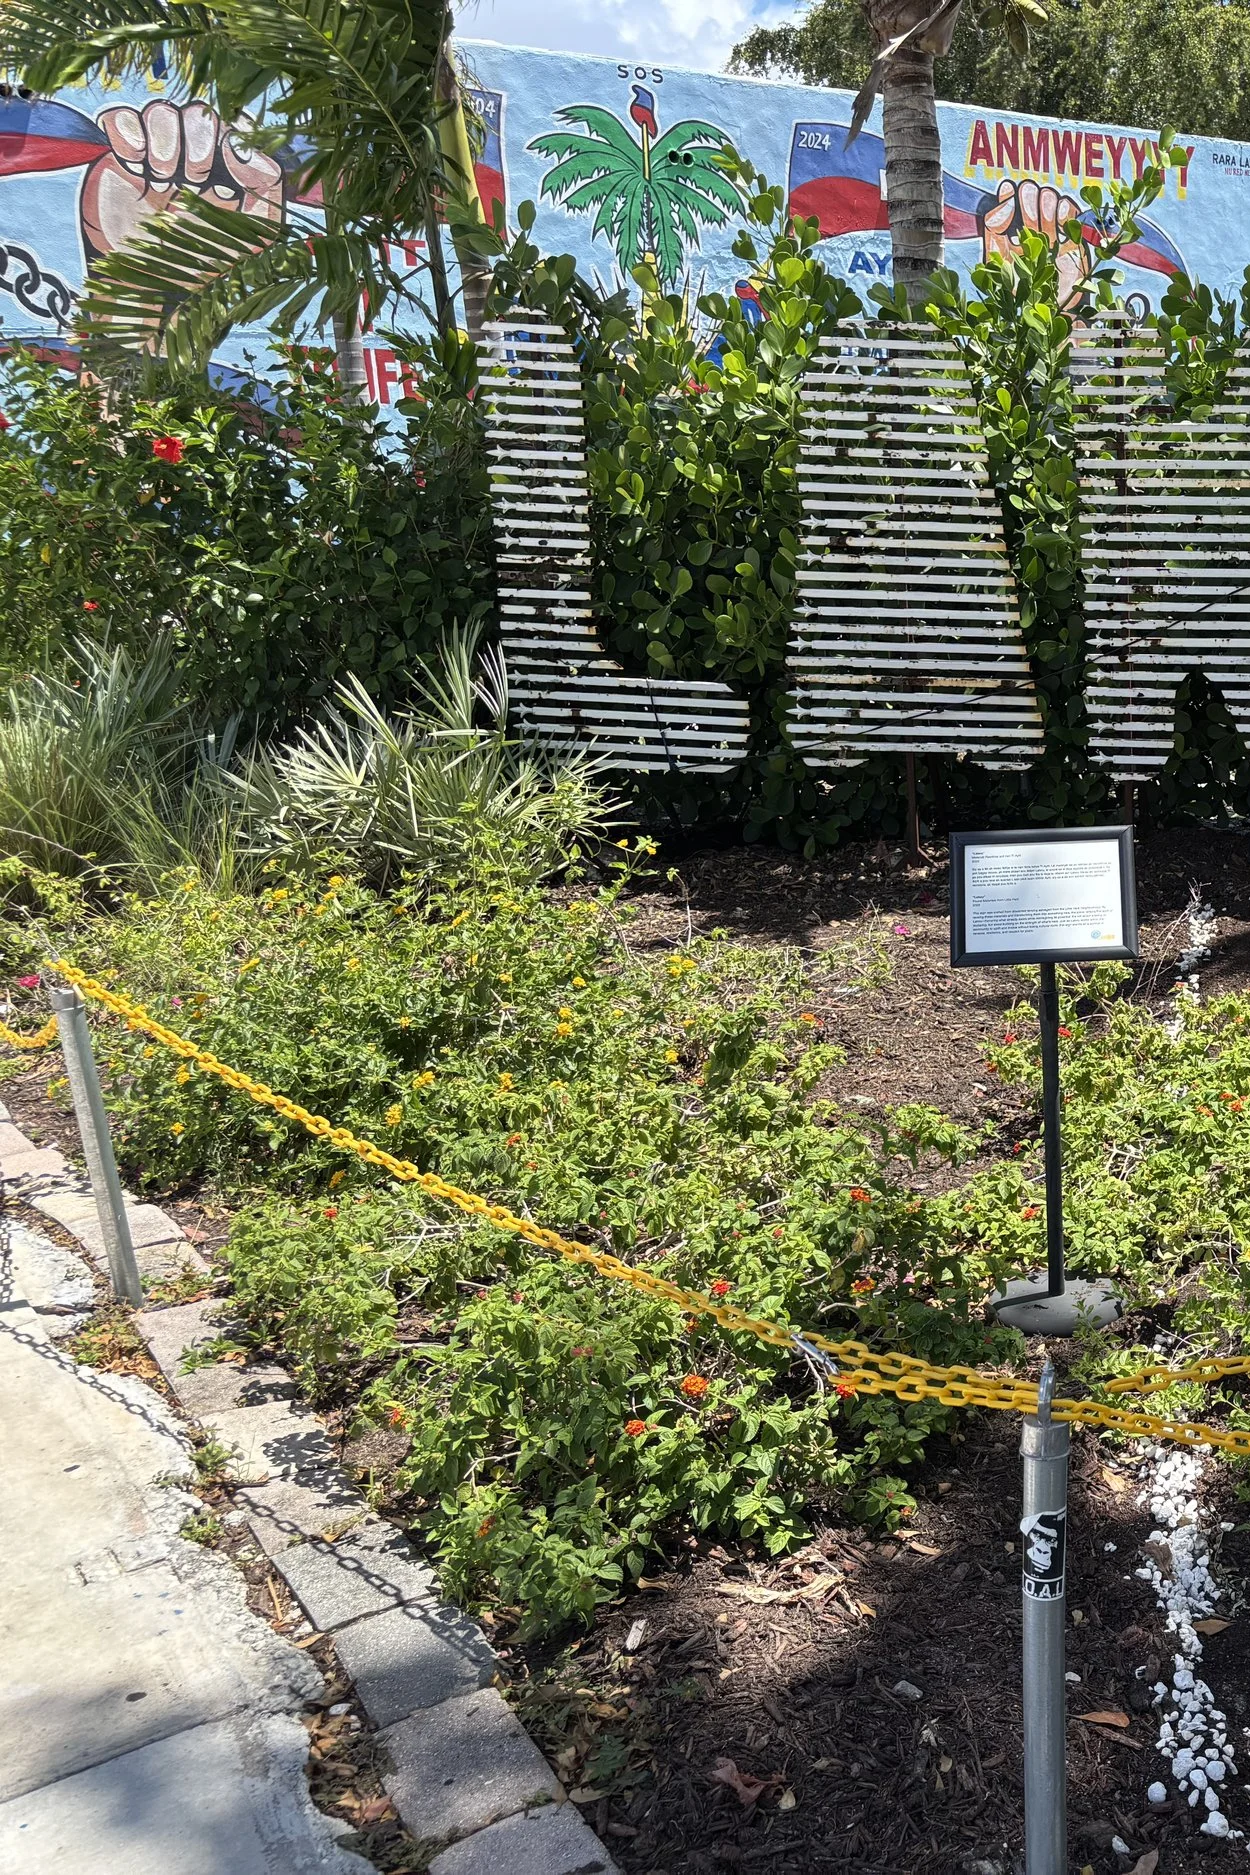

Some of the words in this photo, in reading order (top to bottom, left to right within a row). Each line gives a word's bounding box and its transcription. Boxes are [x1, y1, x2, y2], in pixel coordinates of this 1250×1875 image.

[617, 64, 664, 84] SOS
[798, 130, 831, 151] 2024
[1212, 153, 1237, 166] RARA
